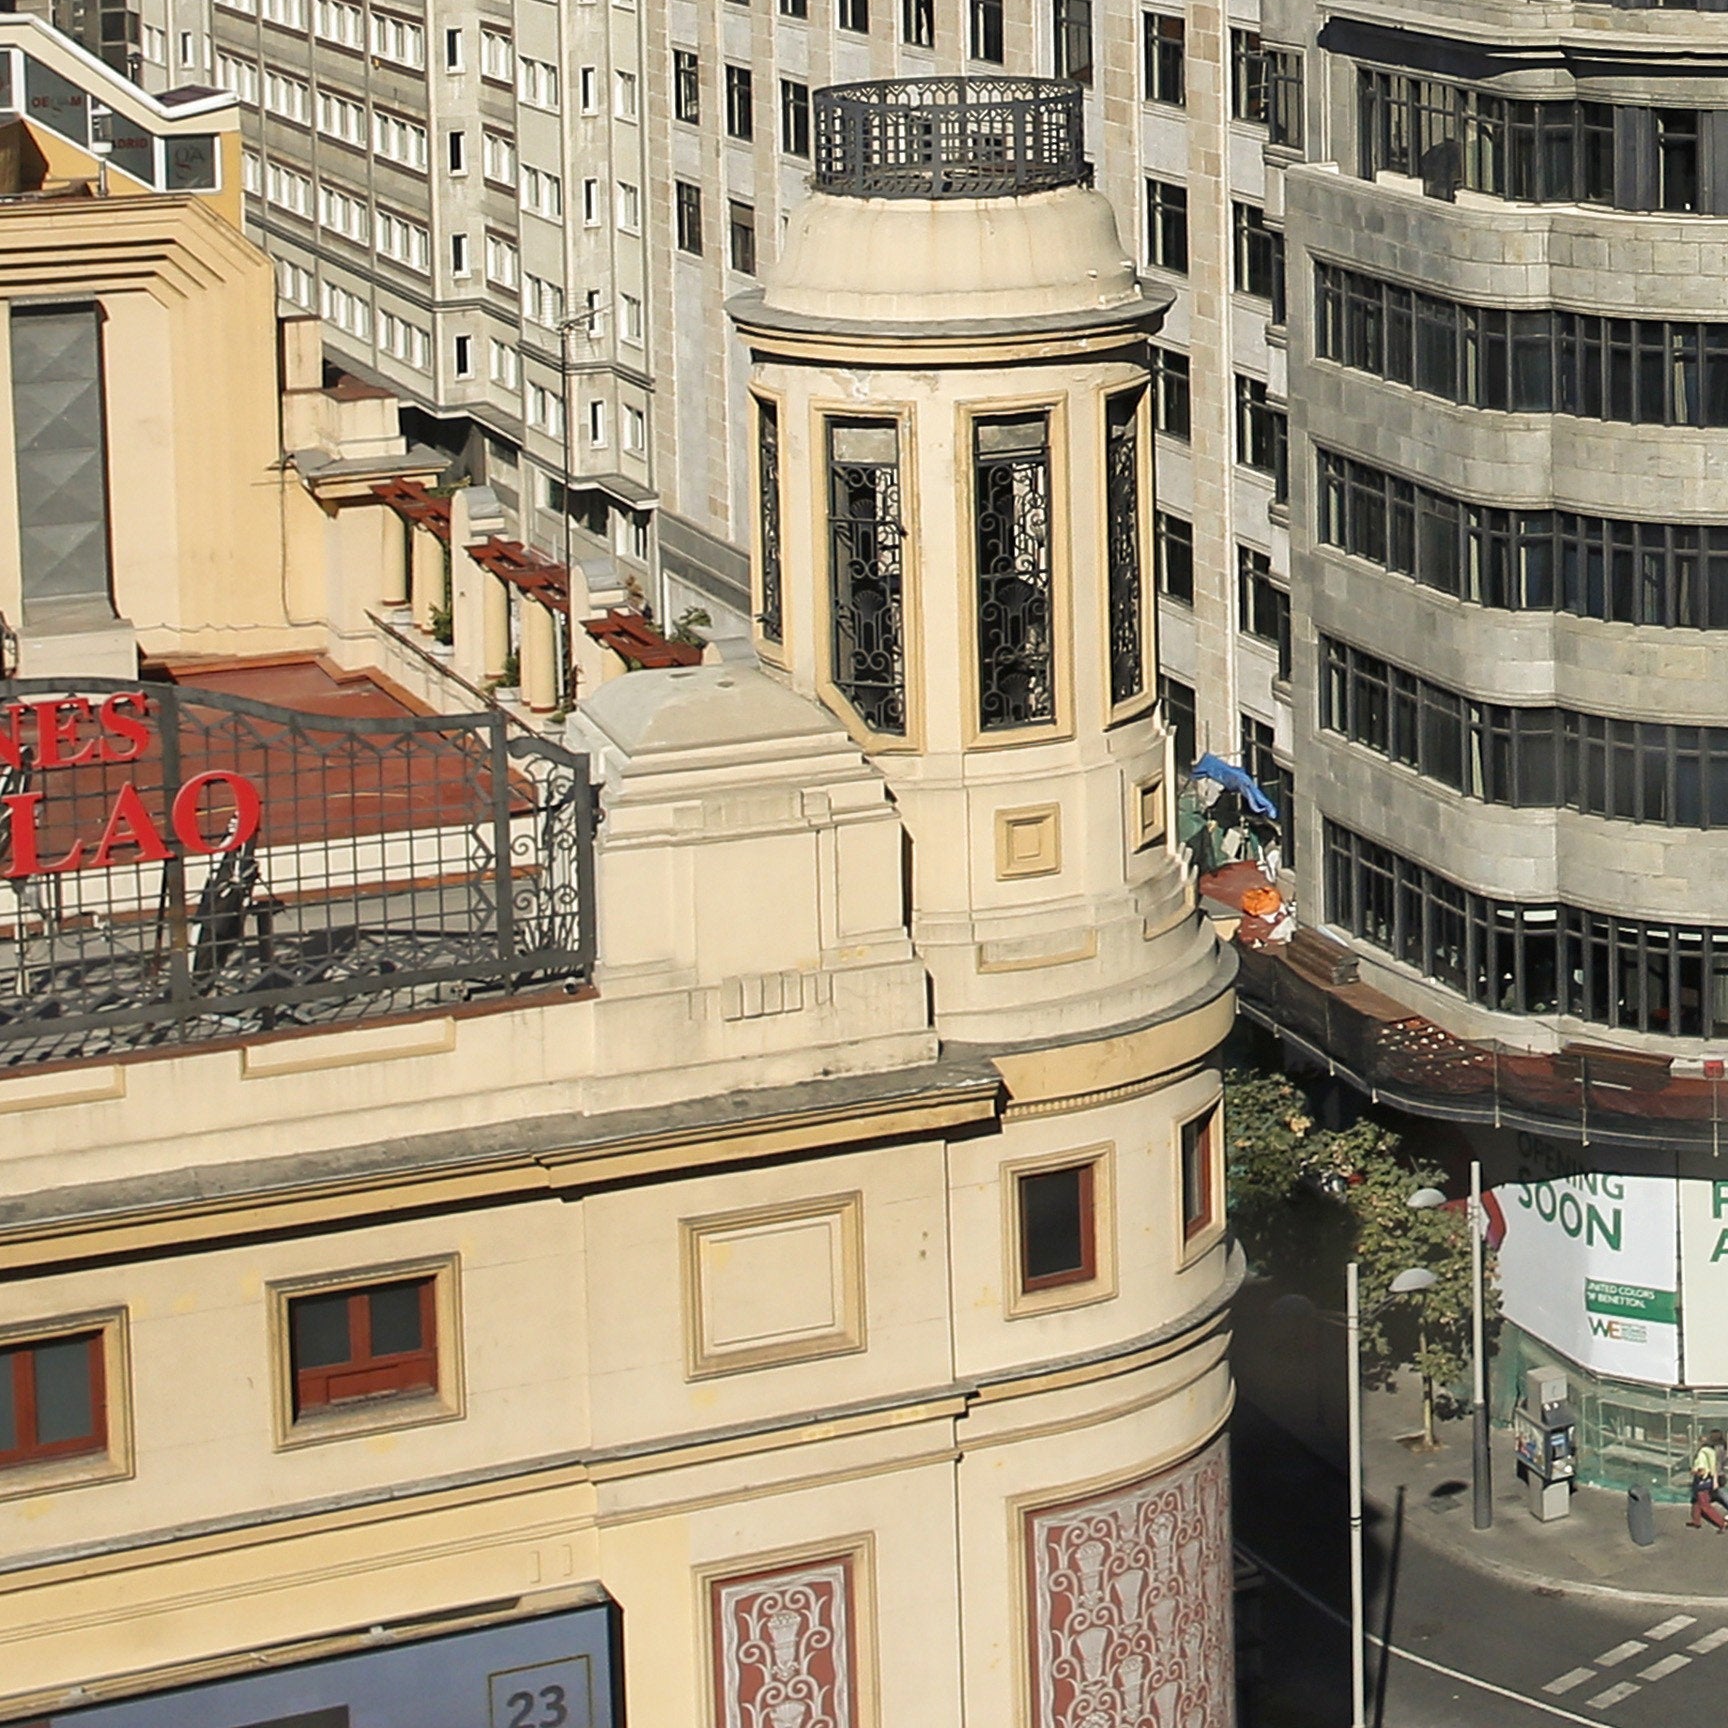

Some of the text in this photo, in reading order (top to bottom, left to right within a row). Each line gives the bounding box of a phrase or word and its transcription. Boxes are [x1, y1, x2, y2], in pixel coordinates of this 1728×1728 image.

[2, 769, 260, 877] LAO
[1518, 1165, 1622, 1251] SOON
[1588, 1282, 1655, 1299] NITED COLORS
[1588, 1316, 1621, 1338] WE
[507, 1684, 566, 1728] 23
